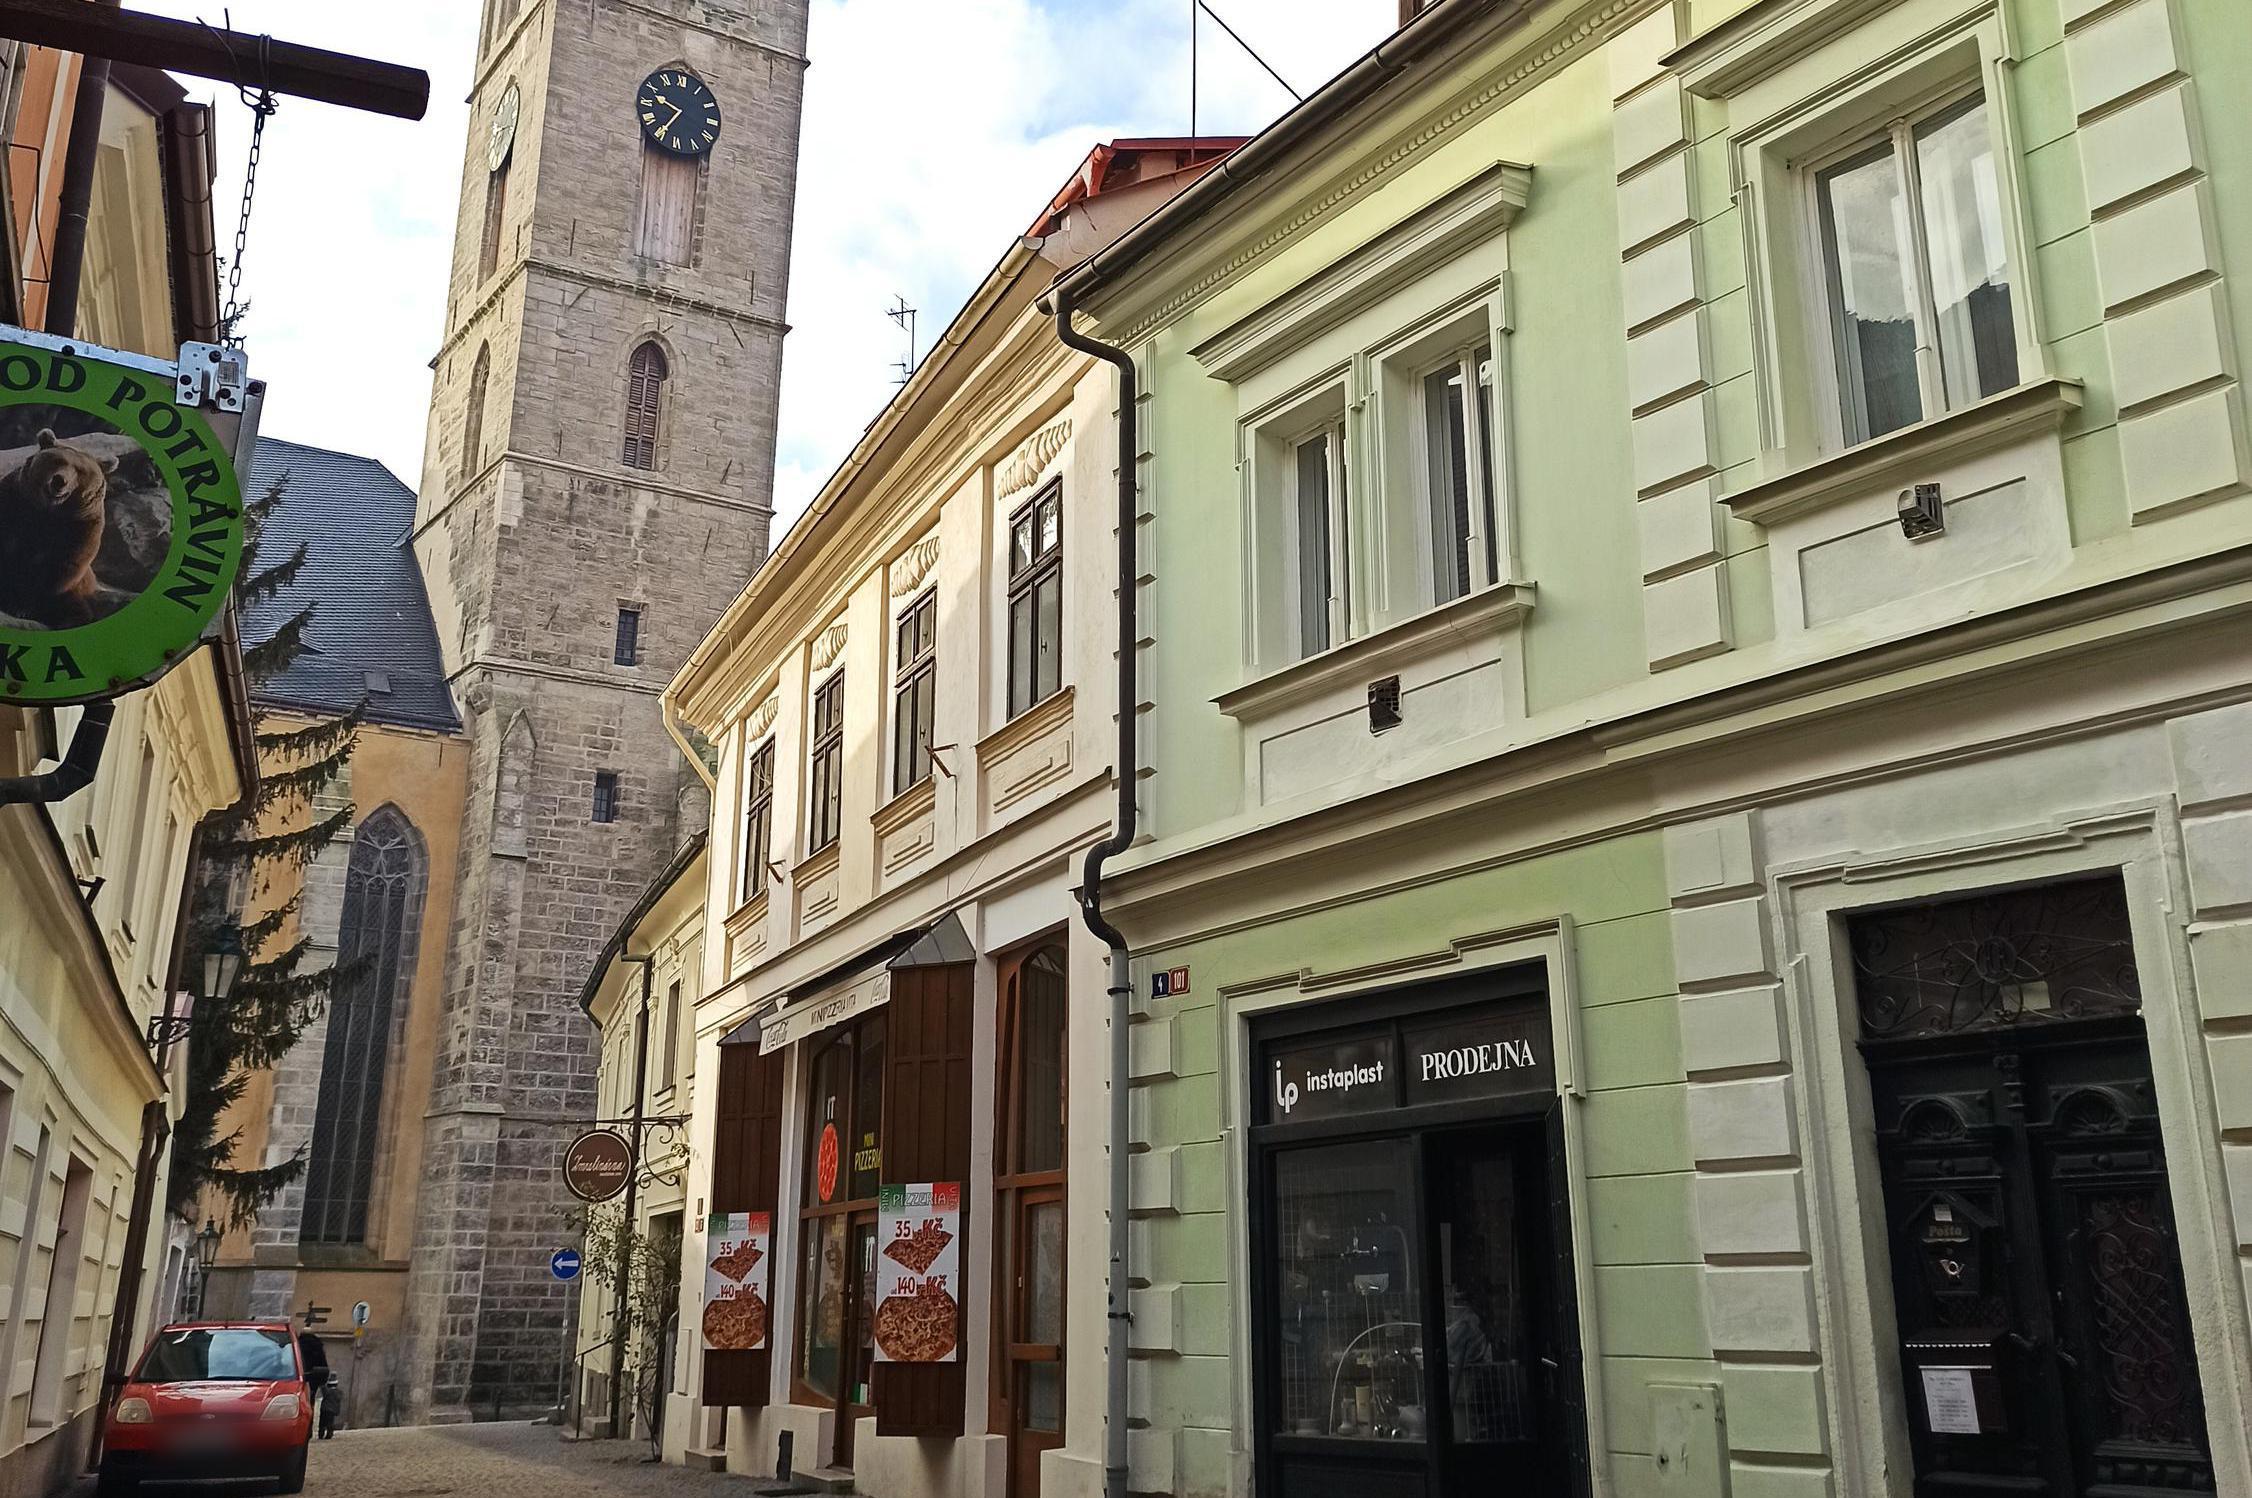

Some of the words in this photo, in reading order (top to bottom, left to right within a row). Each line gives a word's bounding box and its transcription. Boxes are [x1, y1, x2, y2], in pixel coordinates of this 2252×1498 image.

[105, 376, 229, 614] POTRAVIN
[1157, 975, 1163, 993] 4
[1174, 970, 1185, 989] 101
[1306, 1060, 1384, 1091] instaplast
[1420, 1039, 1536, 1081] PRODEJNA
